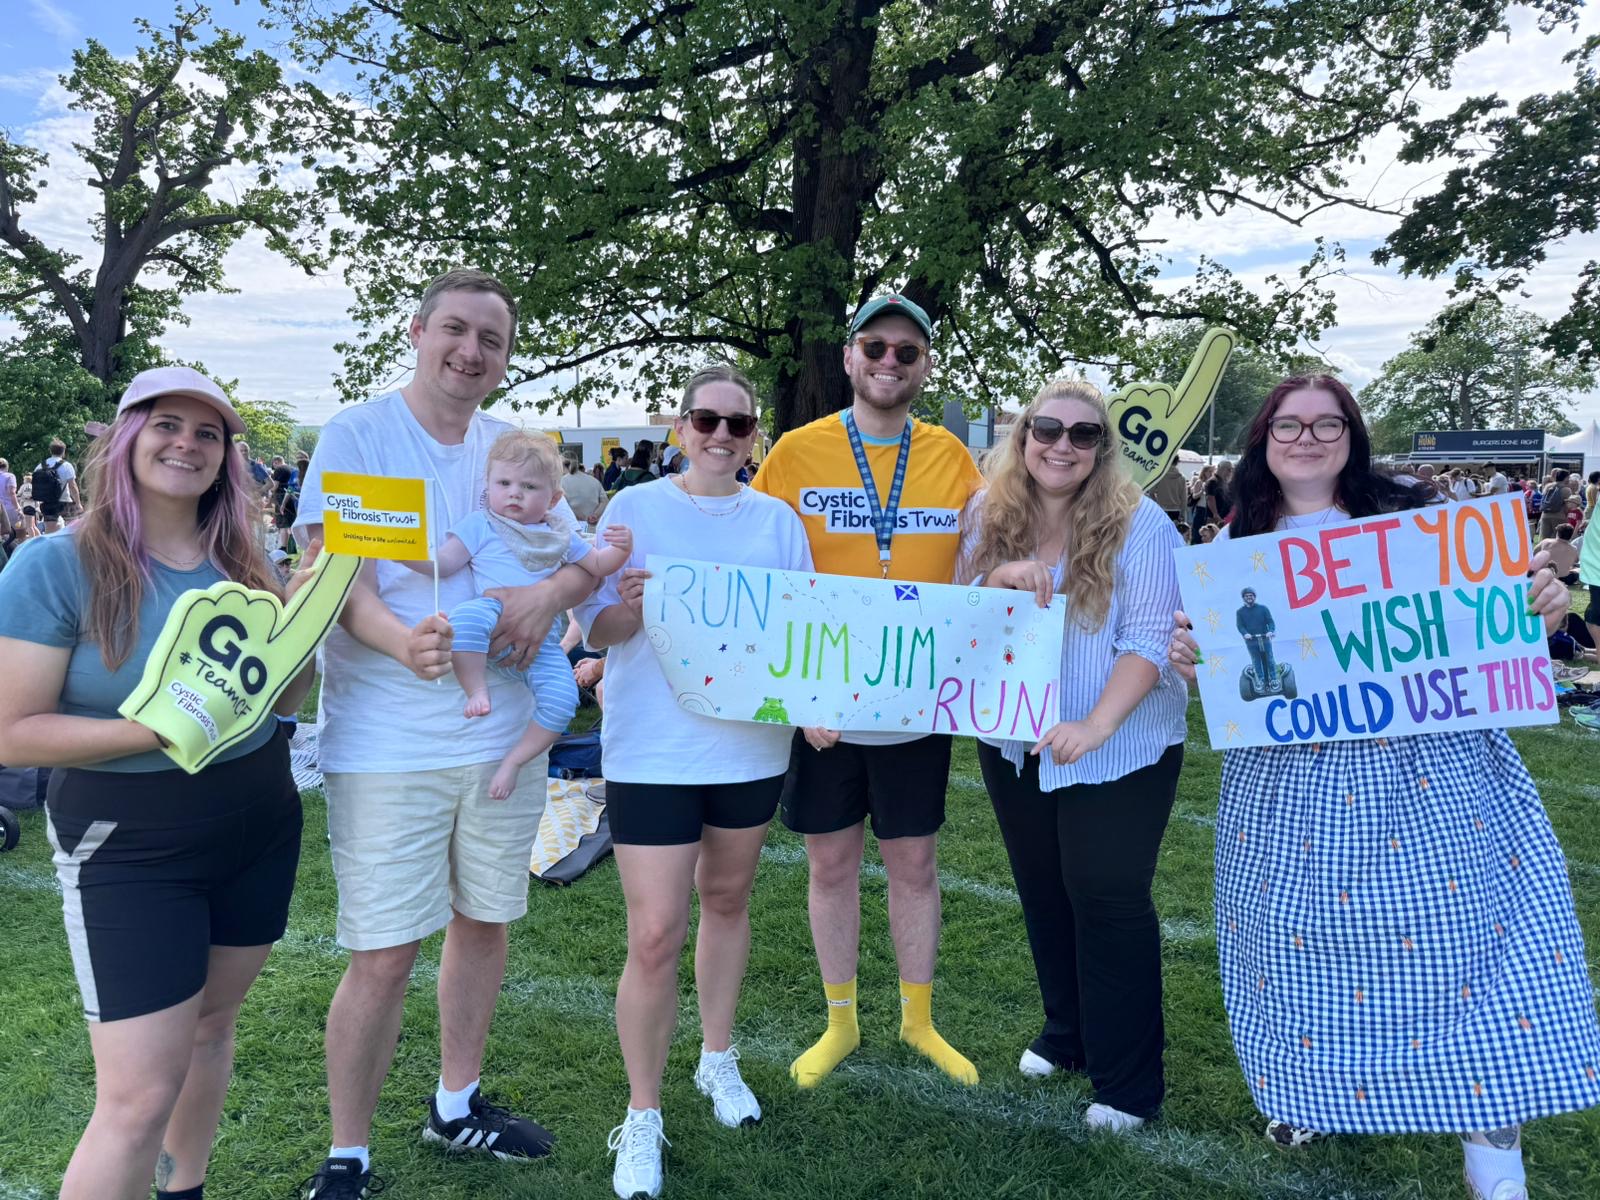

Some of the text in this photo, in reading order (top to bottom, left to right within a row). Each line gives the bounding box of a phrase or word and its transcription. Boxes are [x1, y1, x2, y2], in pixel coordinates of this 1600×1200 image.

[1118, 405, 1169, 457] Go
[1520, 438, 1539, 446] RIGHT
[326, 495, 360, 509] Cystic
[342, 508, 417, 525] Fibrosis Trust
[803, 490, 866, 512] Cystic
[831, 510, 957, 528] Fibris Trust
[1278, 498, 1530, 609] BET YOU
[661, 564, 771, 632] RUN
[1321, 582, 1541, 673] WISH YOU
[198, 614, 268, 696] Go
[768, 621, 935, 690] JIM JIM
[171, 681, 204, 706] Cystic
[177, 697, 211, 729] Fibrosis
[1265, 656, 1555, 743] COULD USE THIS
